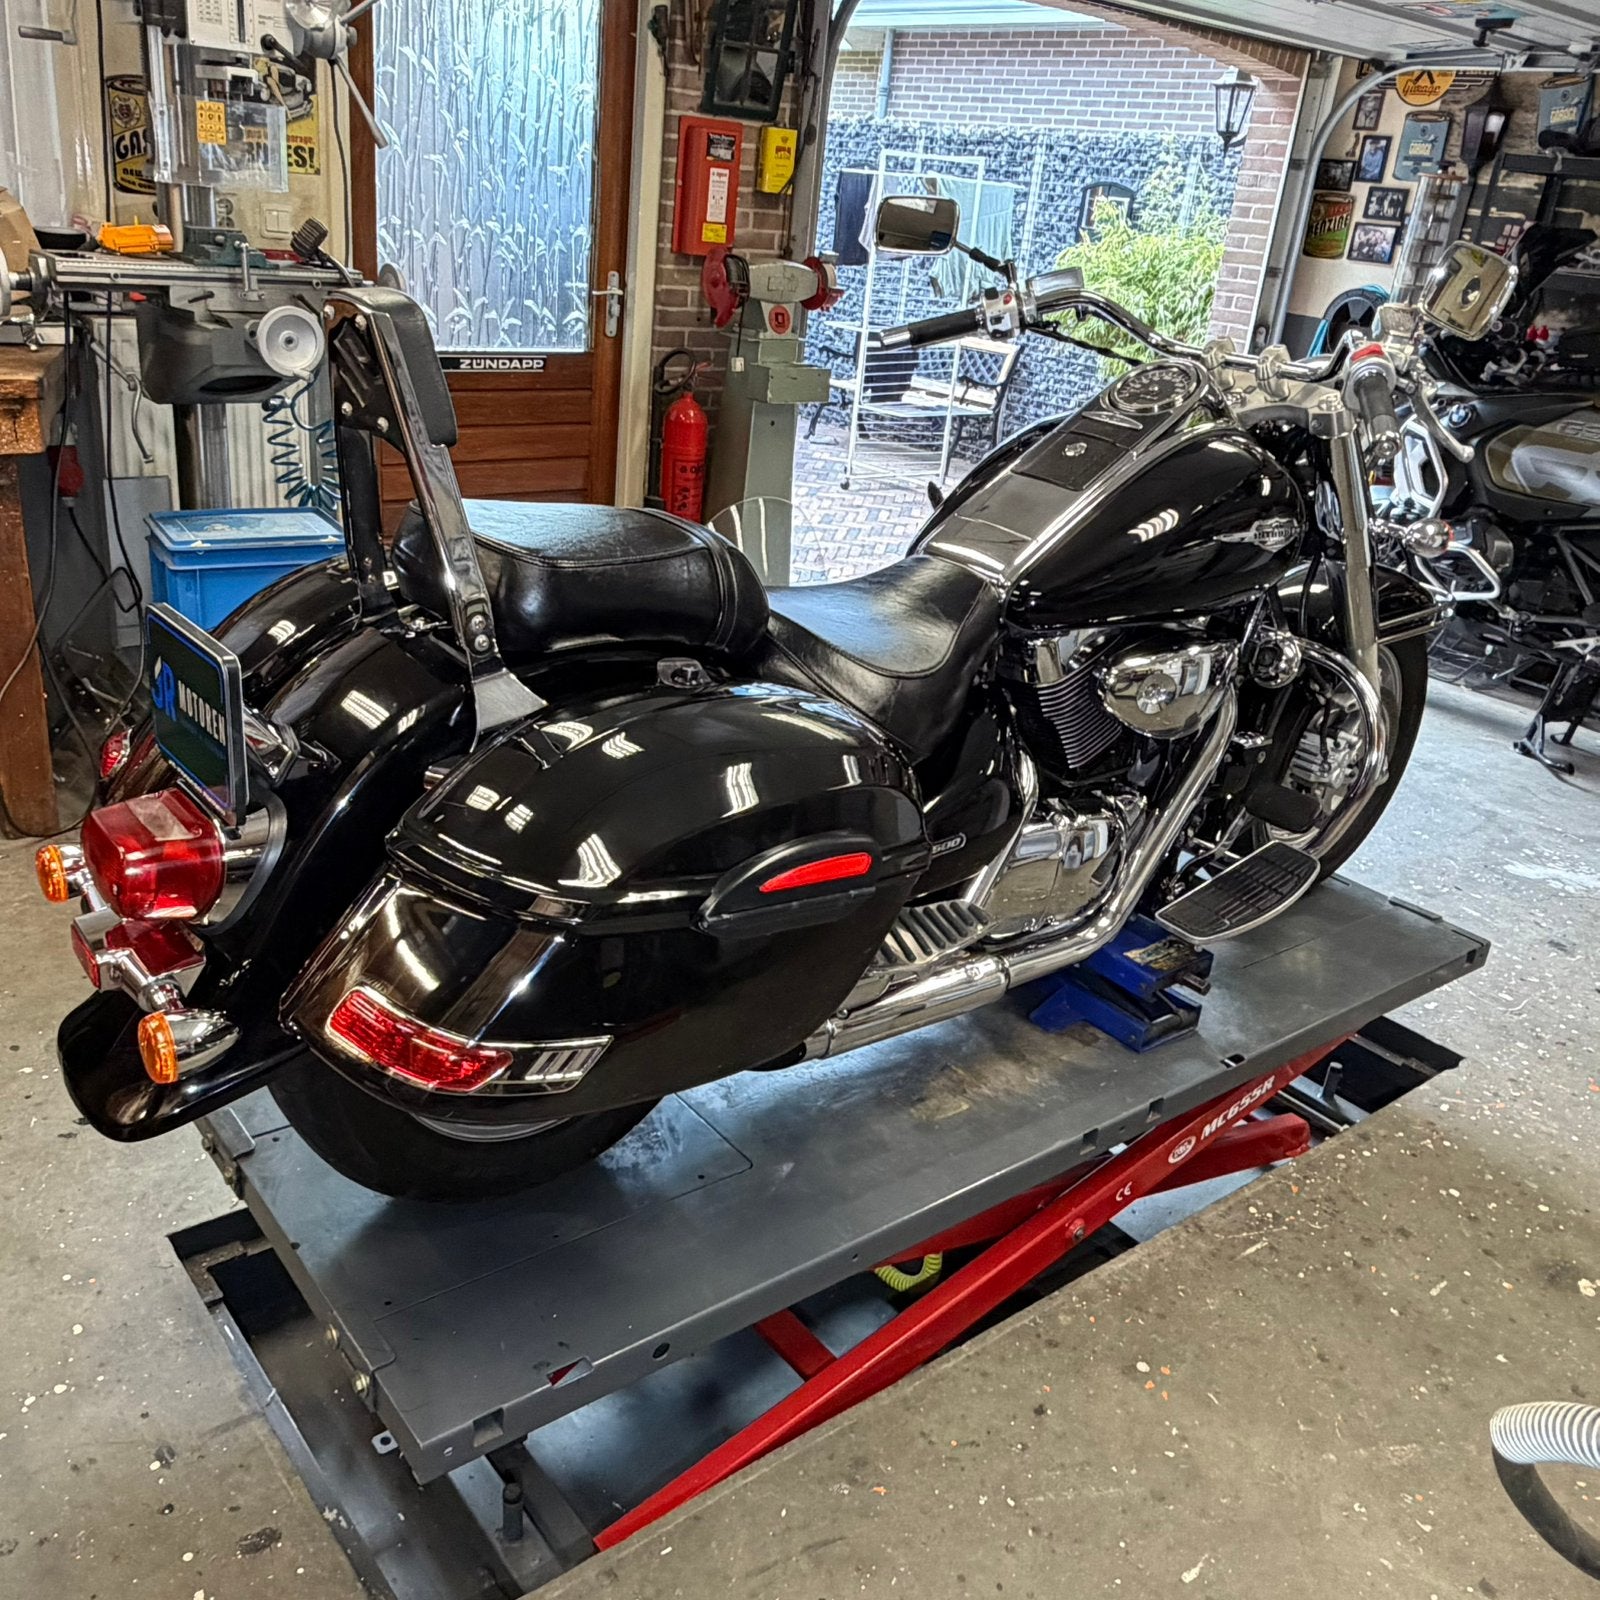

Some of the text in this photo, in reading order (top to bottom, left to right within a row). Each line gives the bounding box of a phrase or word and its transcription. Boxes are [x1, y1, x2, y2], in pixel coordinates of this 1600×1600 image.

[459, 358, 544, 369] ZÜNDAPP
[178, 679, 227, 748] MOTOREN
[1200, 1074, 1276, 1141] MC655R
